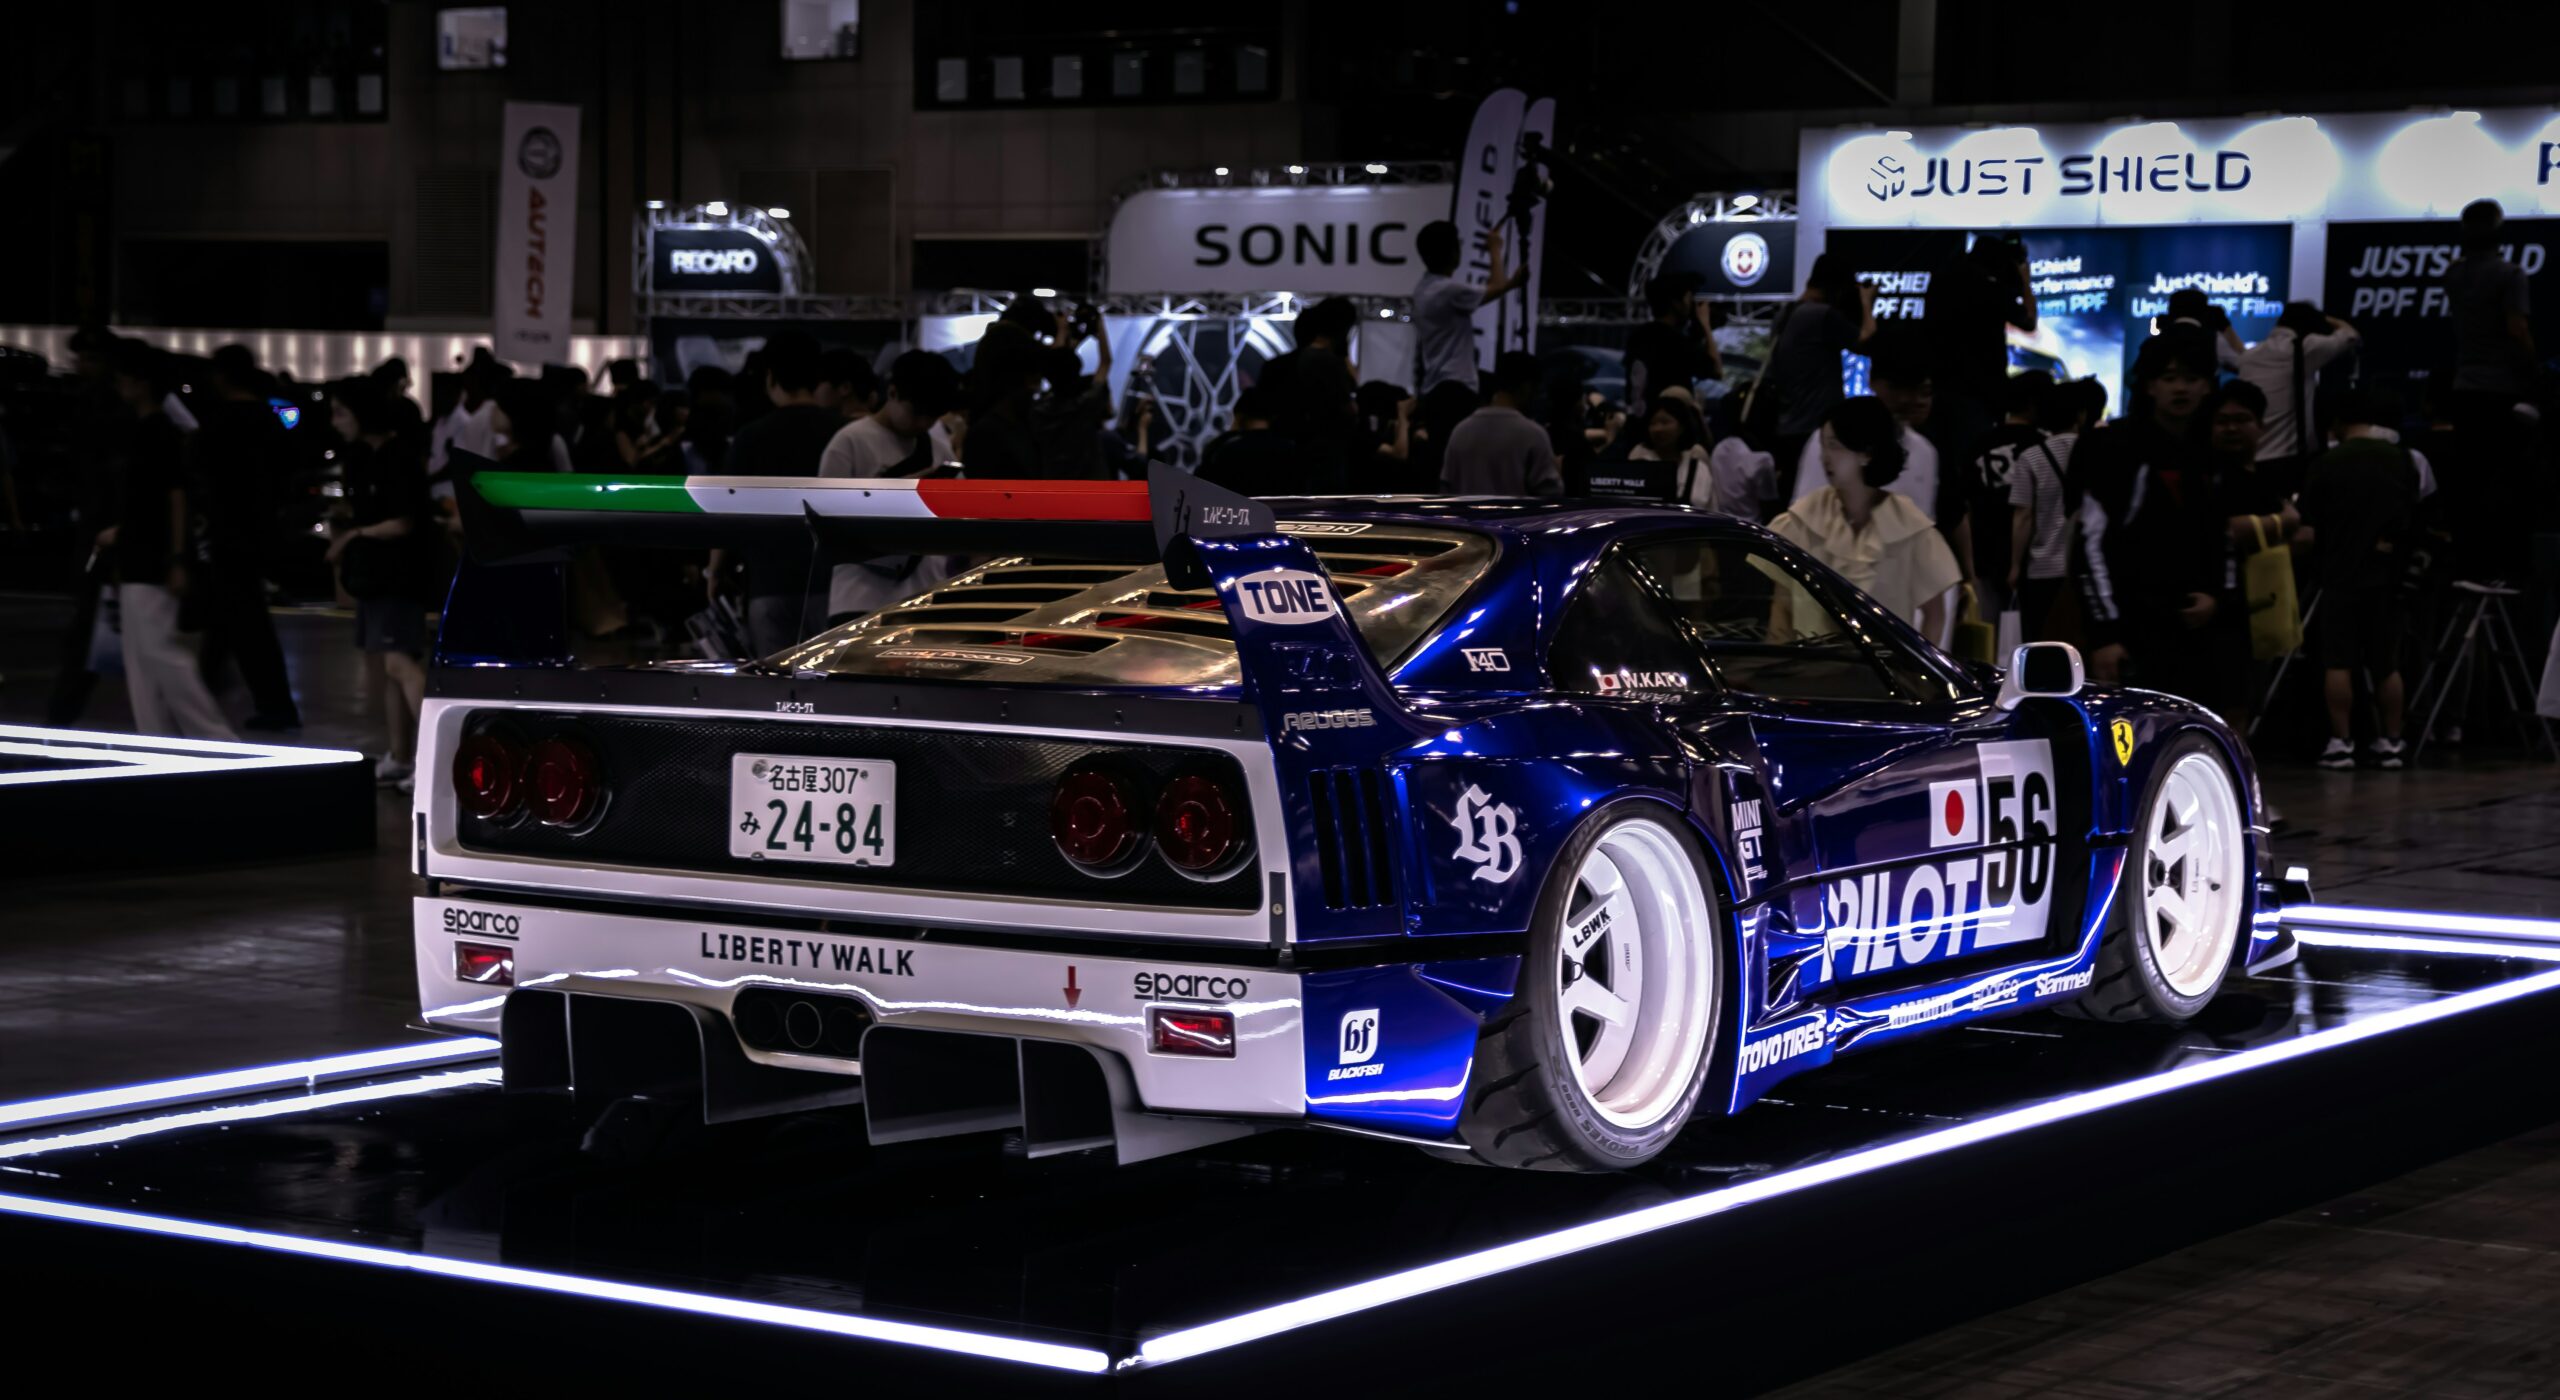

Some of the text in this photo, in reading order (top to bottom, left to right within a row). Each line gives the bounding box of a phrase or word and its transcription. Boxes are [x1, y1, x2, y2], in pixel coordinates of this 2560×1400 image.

[1911, 150, 2252, 197] JUST SHIELD
[526, 186, 547, 319] AUTECH
[669, 248, 759, 275] RECARO
[1196, 223, 1406, 266] SONIC
[2069, 290, 2109, 314] PPF
[2350, 286, 2418, 319] PPF
[1243, 579, 1329, 615] TONE
[739, 798, 885, 857] み 24-84
[1450, 783, 1523, 884] LB
[1731, 799, 1762, 832] MINI
[1986, 771, 2052, 906] 56
[443, 907, 521, 937] sparco
[1572, 906, 1611, 949] LBWK
[1819, 857, 1979, 983] PILOT
[701, 931, 915, 977] LIBERTY WALK
[1133, 971, 1248, 1003] sparco
[1343, 1017, 1376, 1054] bf
